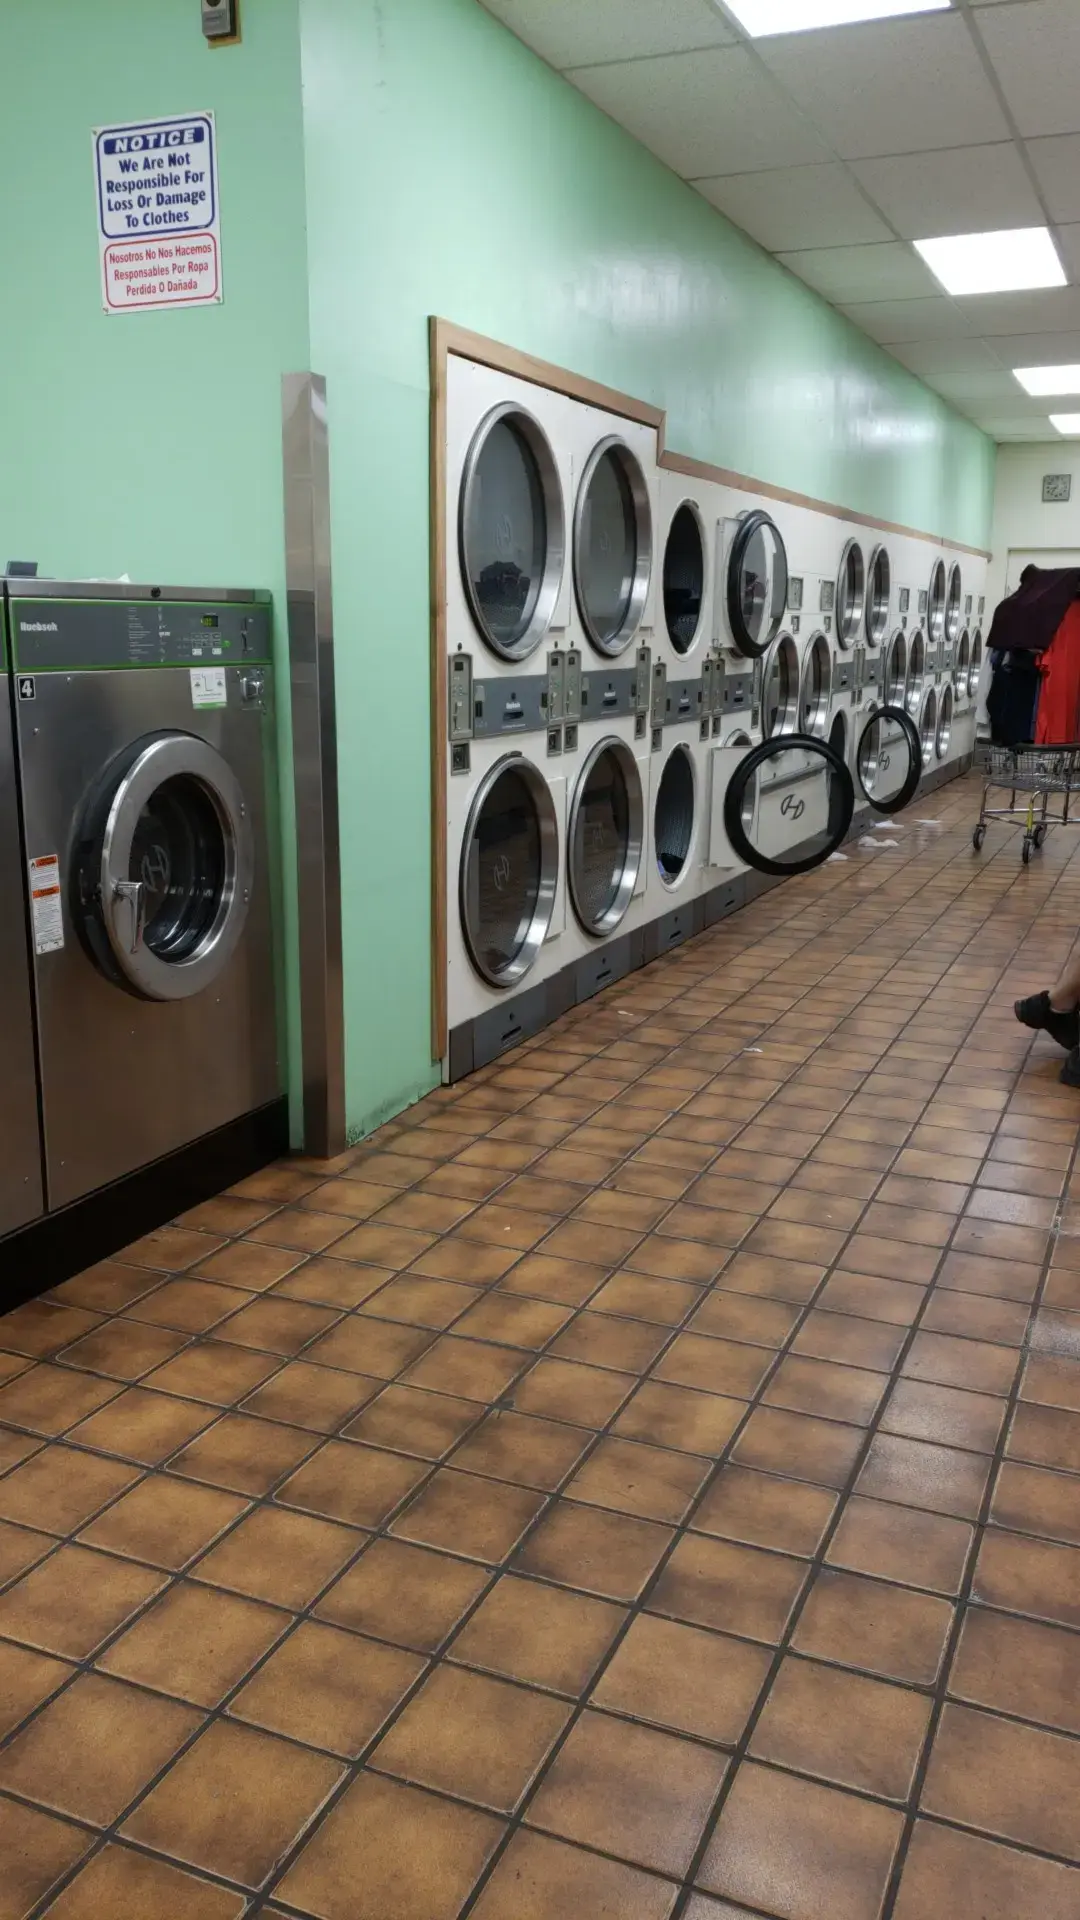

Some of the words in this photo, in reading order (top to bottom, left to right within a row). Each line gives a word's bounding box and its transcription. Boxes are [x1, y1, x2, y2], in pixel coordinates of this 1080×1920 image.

[115, 129, 195, 153] NOTICE
[119, 158, 138, 173] We
[143, 155, 164, 170] Are
[168, 152, 191, 167] Not
[106, 173, 180, 194] Responsible
[185, 170, 205, 184] For
[108, 197, 133, 212] Loss
[137, 194, 152, 208] Or
[156, 189, 206, 207] Damage
[125, 214, 139, 228] To
[143, 210, 189, 226] Clothes
[109, 250, 144, 264] Nosotros
[145, 249, 156, 261] No
[158, 247, 173, 259] Nos
[175, 243, 212, 257] Hacemos
[114, 266, 169, 282] Responsables
[172, 263, 185, 275] Por
[188, 261, 208, 275] Ropa
[126, 282, 156, 297] Perdida
[159, 281, 165, 293] O
[167, 278, 198, 292] Dañada
[21, 680, 32, 697] 4
